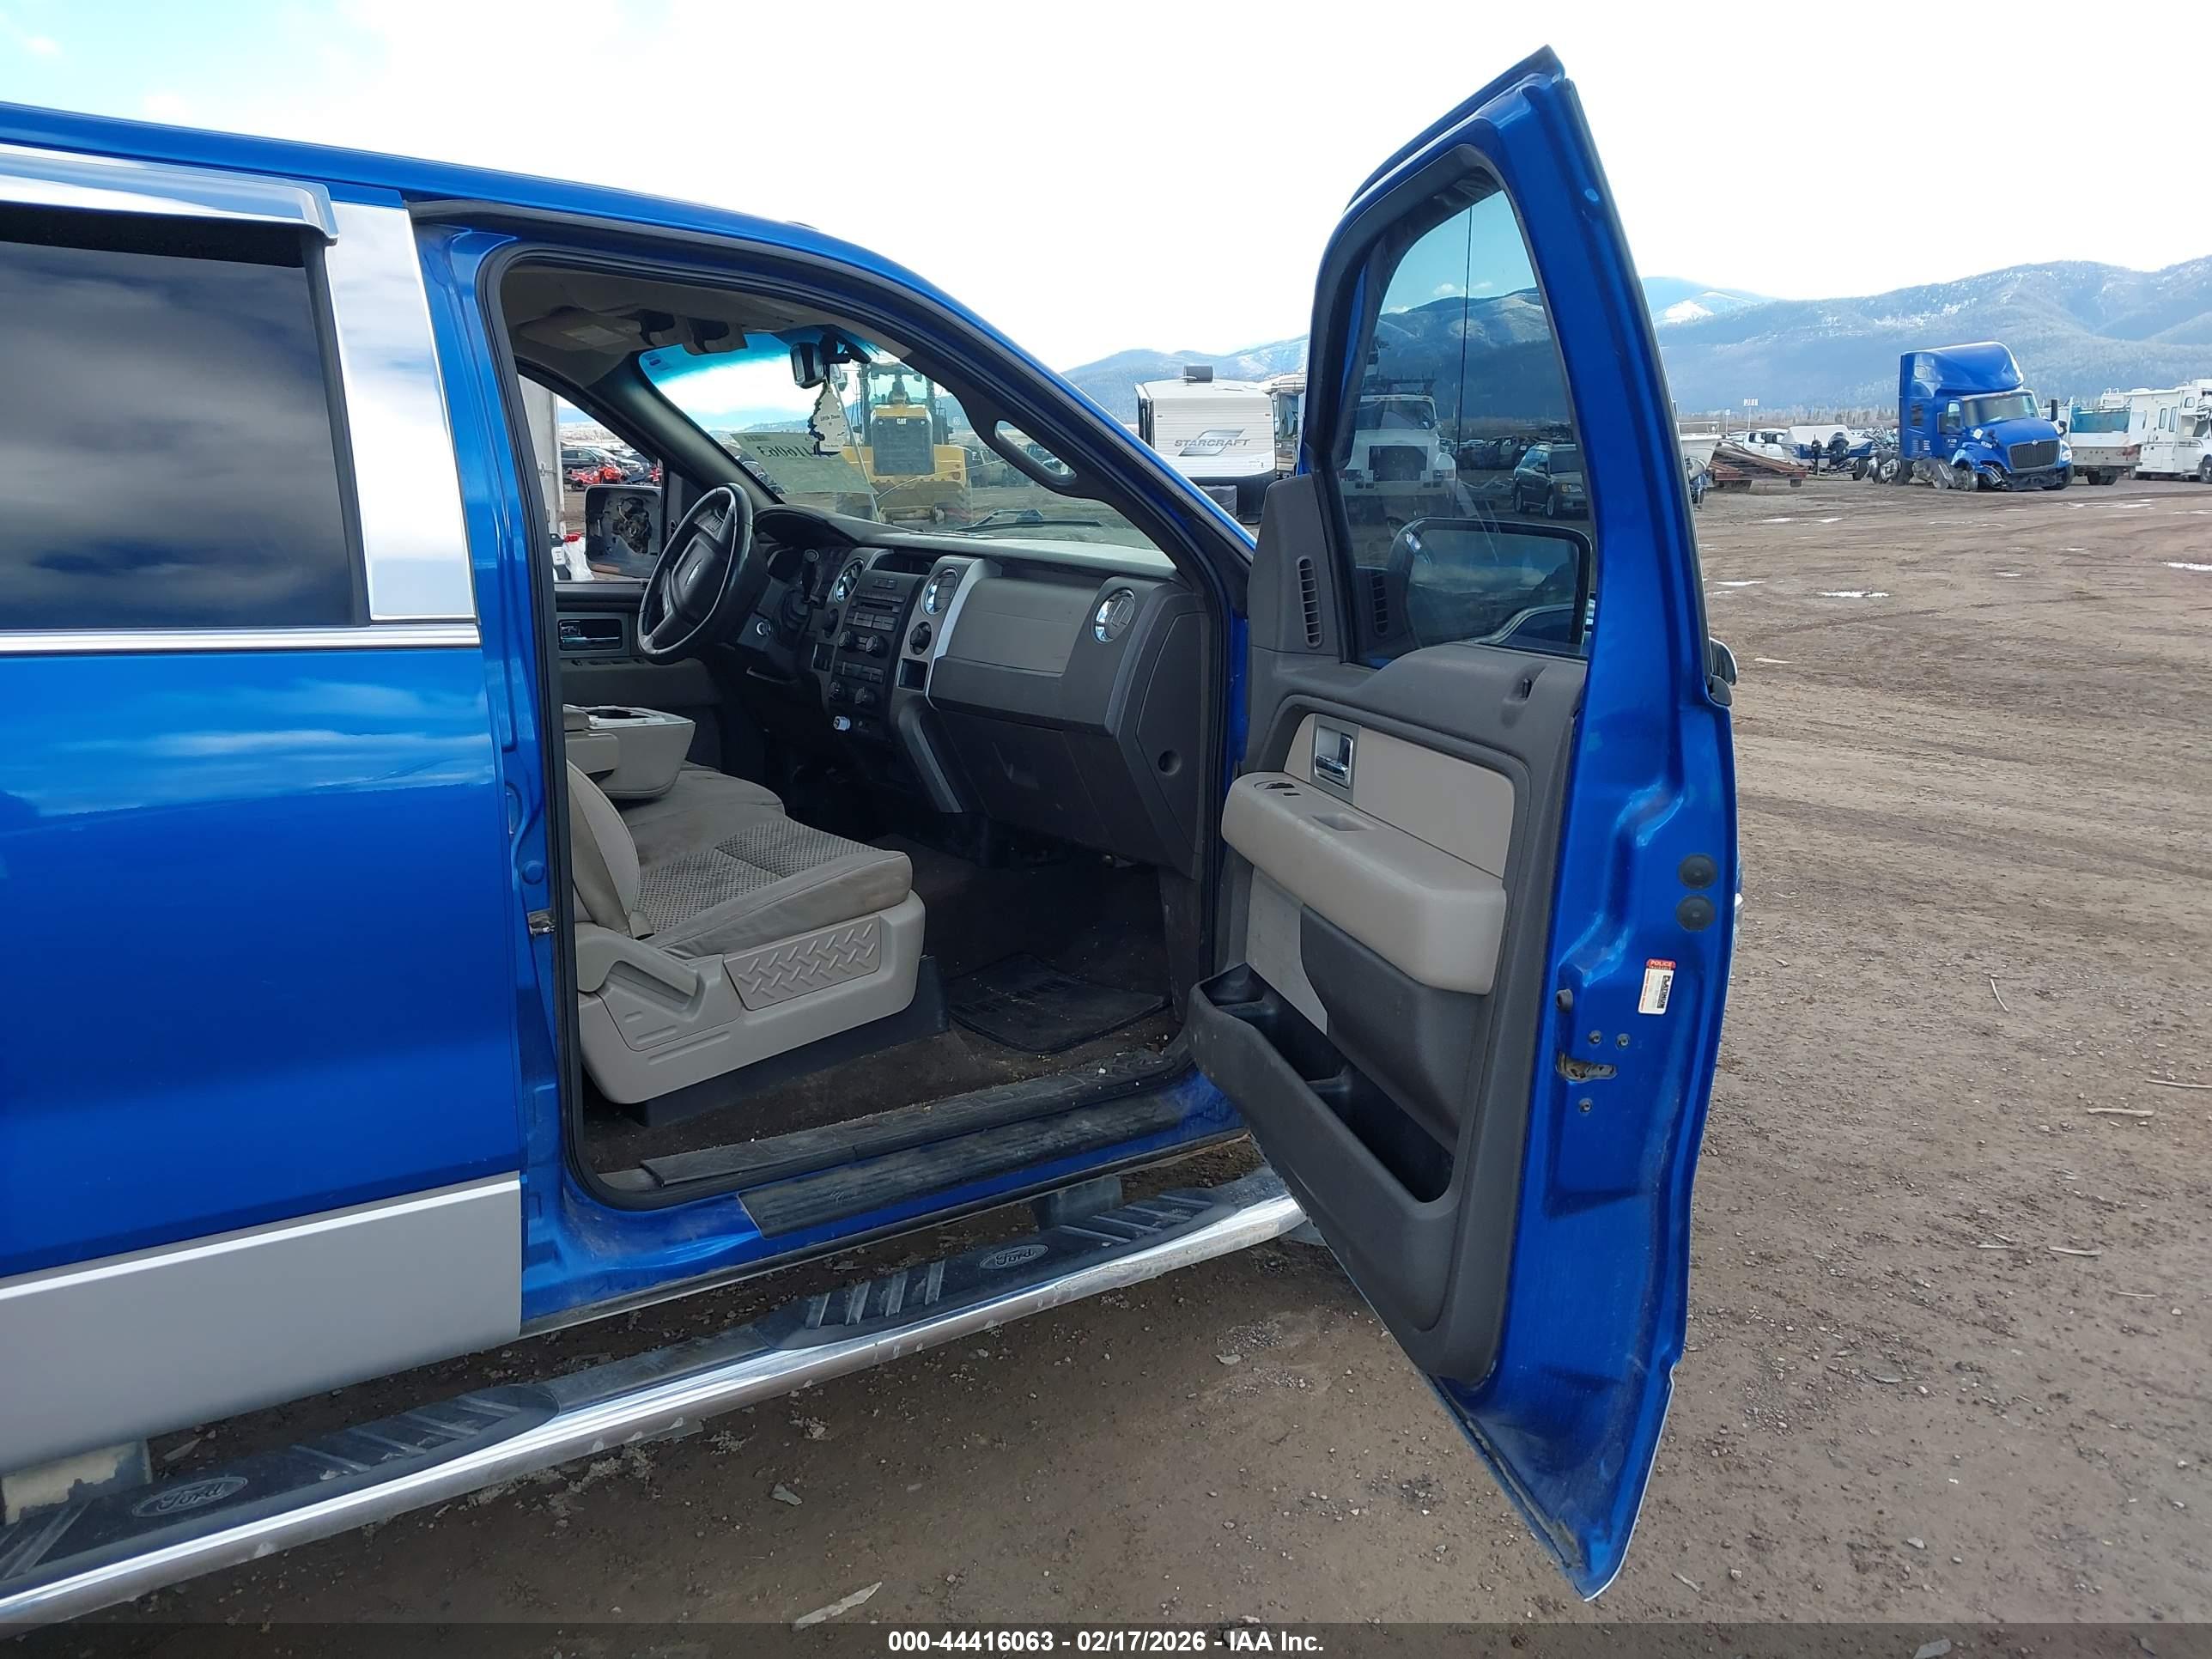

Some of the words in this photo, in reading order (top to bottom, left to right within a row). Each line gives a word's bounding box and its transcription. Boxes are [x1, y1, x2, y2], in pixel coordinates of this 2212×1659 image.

[1659, 975, 1671, 1008] PLATINUM
[995, 1249, 1036, 1266] Ford
[156, 1483, 225, 1511] Ford
